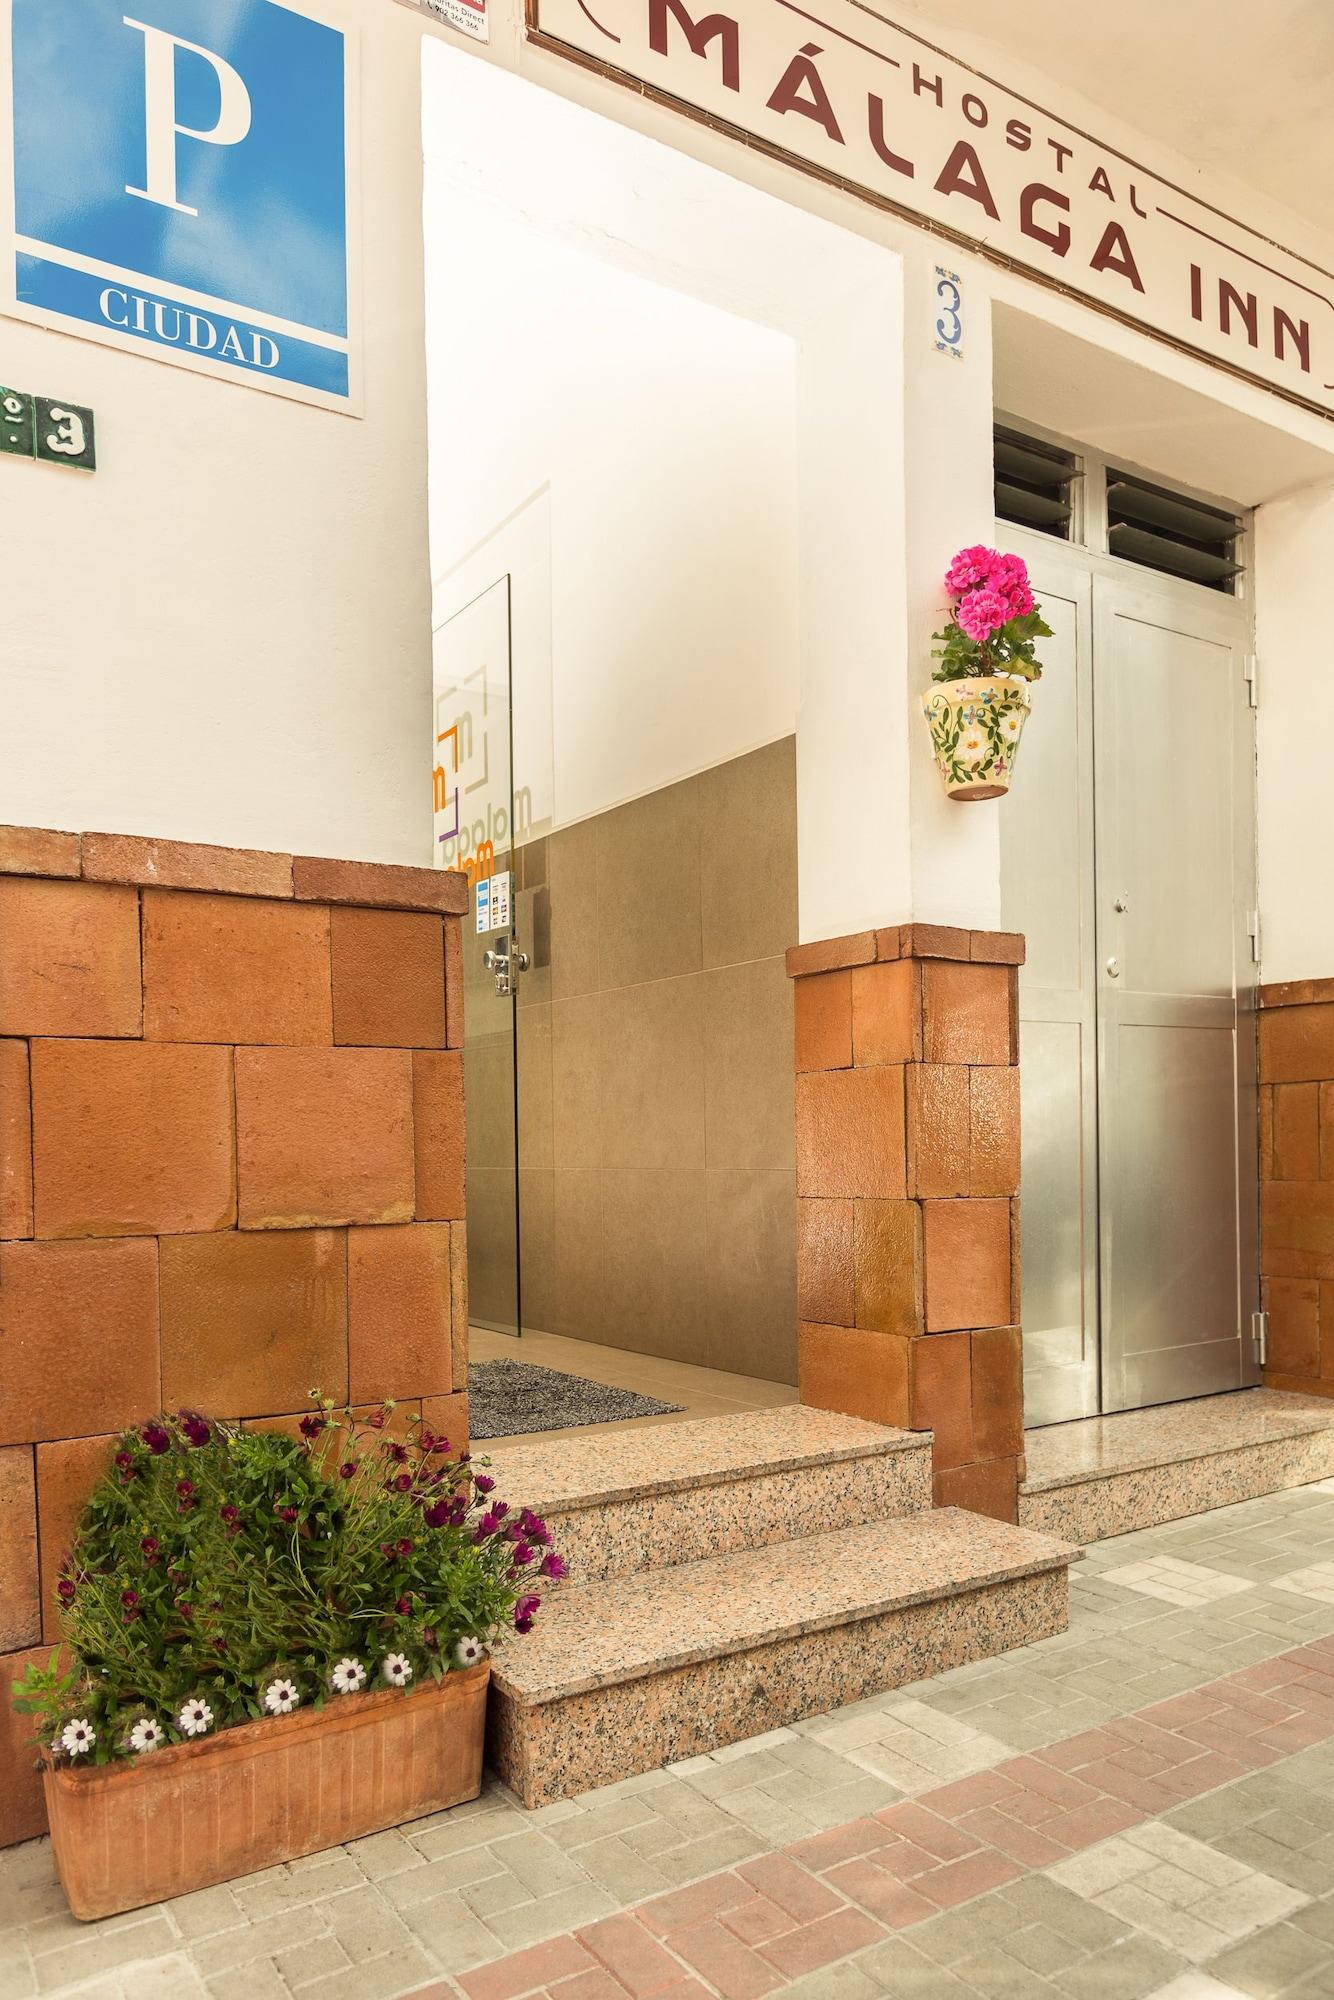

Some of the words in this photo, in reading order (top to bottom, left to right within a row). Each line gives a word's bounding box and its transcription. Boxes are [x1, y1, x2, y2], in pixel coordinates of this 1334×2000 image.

[435, 5, 448, 16] 902
[450, 13, 463, 24] 366
[466, 20, 479, 31] 366
[461, 8, 484, 25] Direct
[123, 15, 252, 217] P
[913, 63, 1147, 220] HOSTAL
[649, 0, 1145, 293] MÁLAGA
[1190, 263, 1310, 374] INN
[99, 287, 281, 370] CIUDAD
[937, 280, 961, 344] 3
[46, 407, 86, 455] 3
